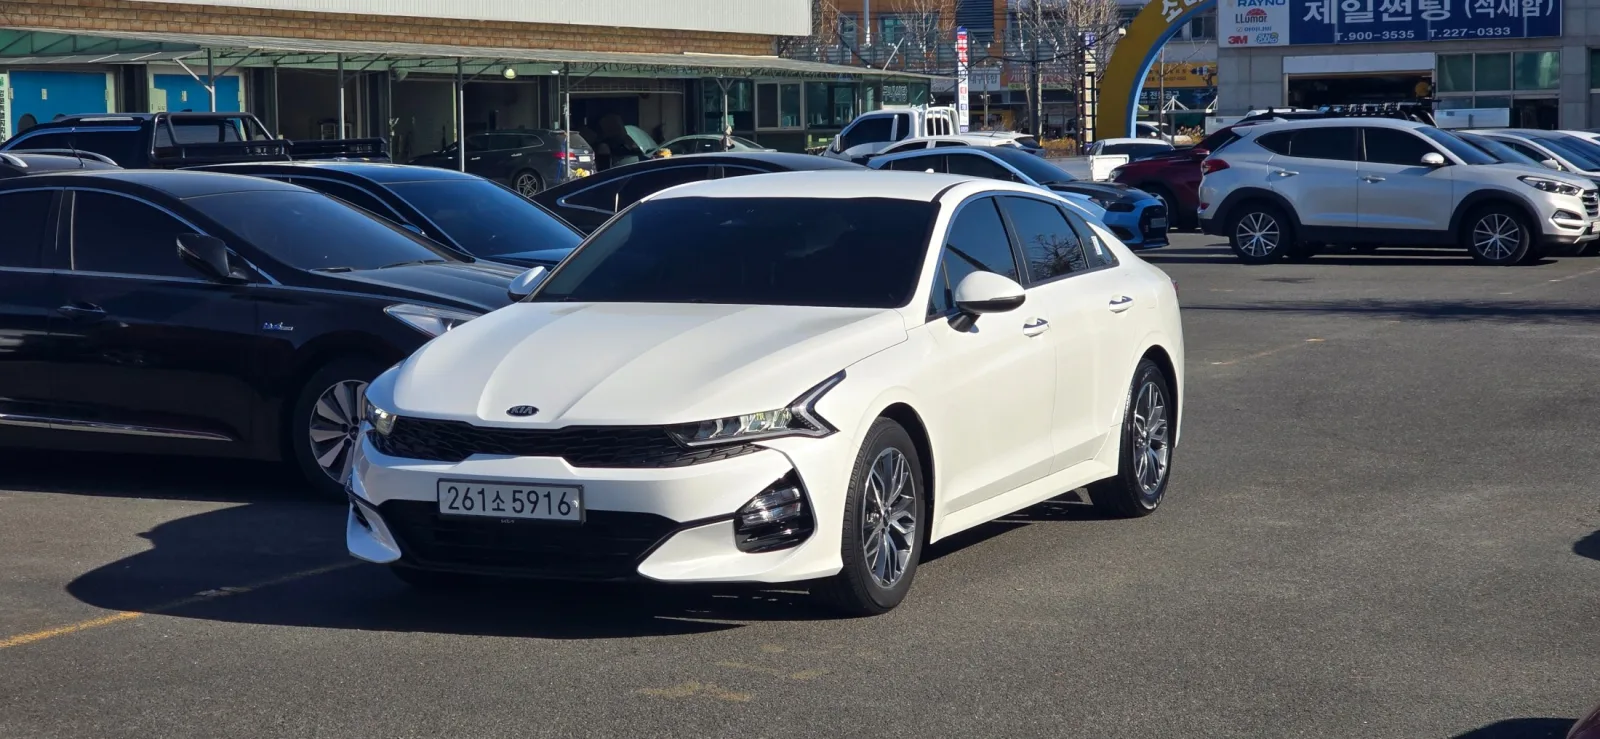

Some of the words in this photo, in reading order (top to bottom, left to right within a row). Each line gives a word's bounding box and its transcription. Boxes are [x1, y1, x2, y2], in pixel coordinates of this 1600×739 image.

[1303, 0, 1450, 24] 제일썬팅
[1228, 35, 1248, 45] 3M
[1335, 30, 1415, 41] T.900-3535
[1428, 27, 1511, 37] T.227-0333
[511, 406, 533, 415] KIA
